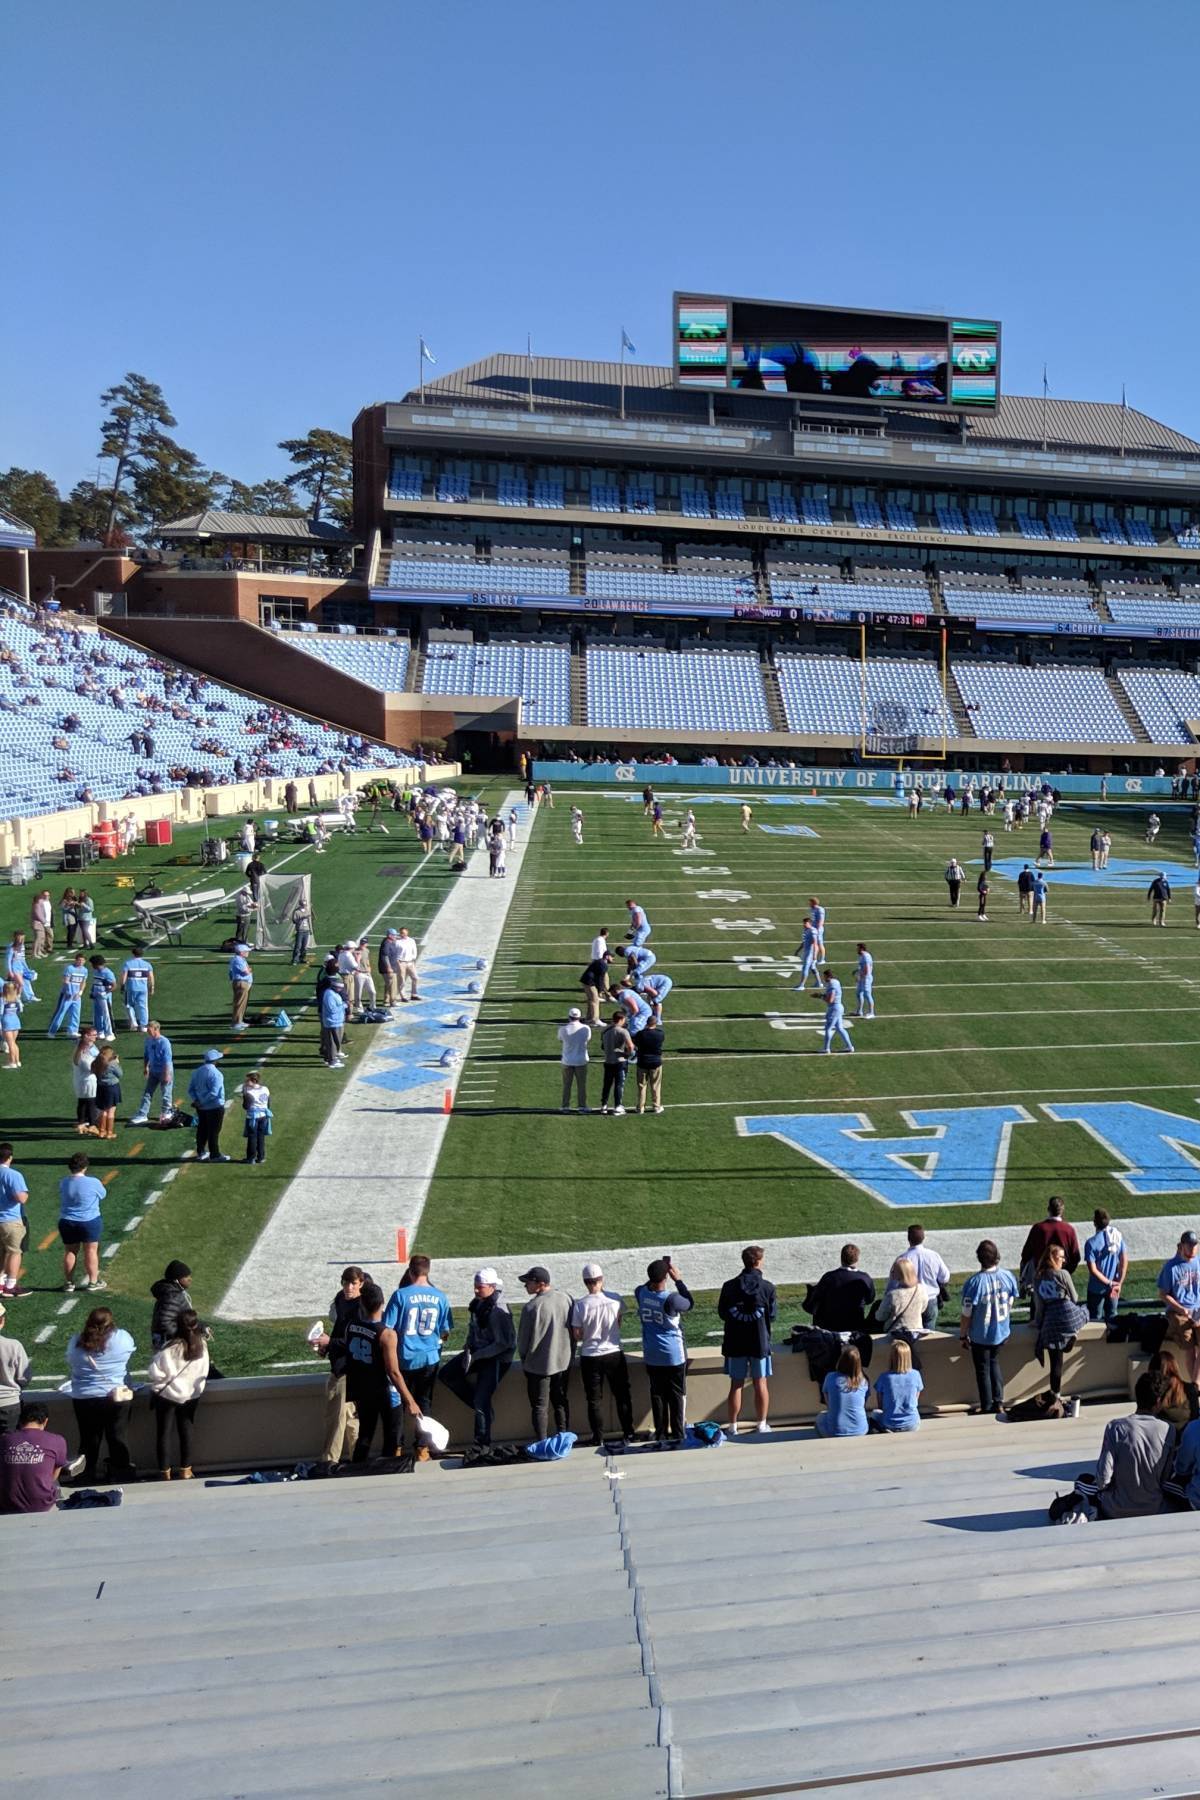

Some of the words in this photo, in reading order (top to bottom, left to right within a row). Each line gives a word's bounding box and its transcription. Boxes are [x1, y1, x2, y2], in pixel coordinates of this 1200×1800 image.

[812, 528, 851, 537] CENTER
[860, 530, 880, 539] FOR
[887, 532, 951, 544] EXCELLENCE
[472, 593, 487, 604] 85
[488, 594, 519, 605] LACEY
[584, 599, 598, 609] 20
[600, 600, 650, 612] LAWRENCE
[763, 609, 782, 618] WCU
[790, 610, 798, 620] 0
[834, 612, 850, 621] UNC
[858, 612, 866, 623] 0
[887, 615, 911, 625] 47:31
[1071, 623, 1103, 635] COOPER
[728, 768, 847, 787] UNIVERSITY
[855, 770, 877, 787] OF
[958, 774, 1046, 791] CAROLINA
[406, 1307, 439, 1336] 10
[642, 1308, 664, 1325] 23
